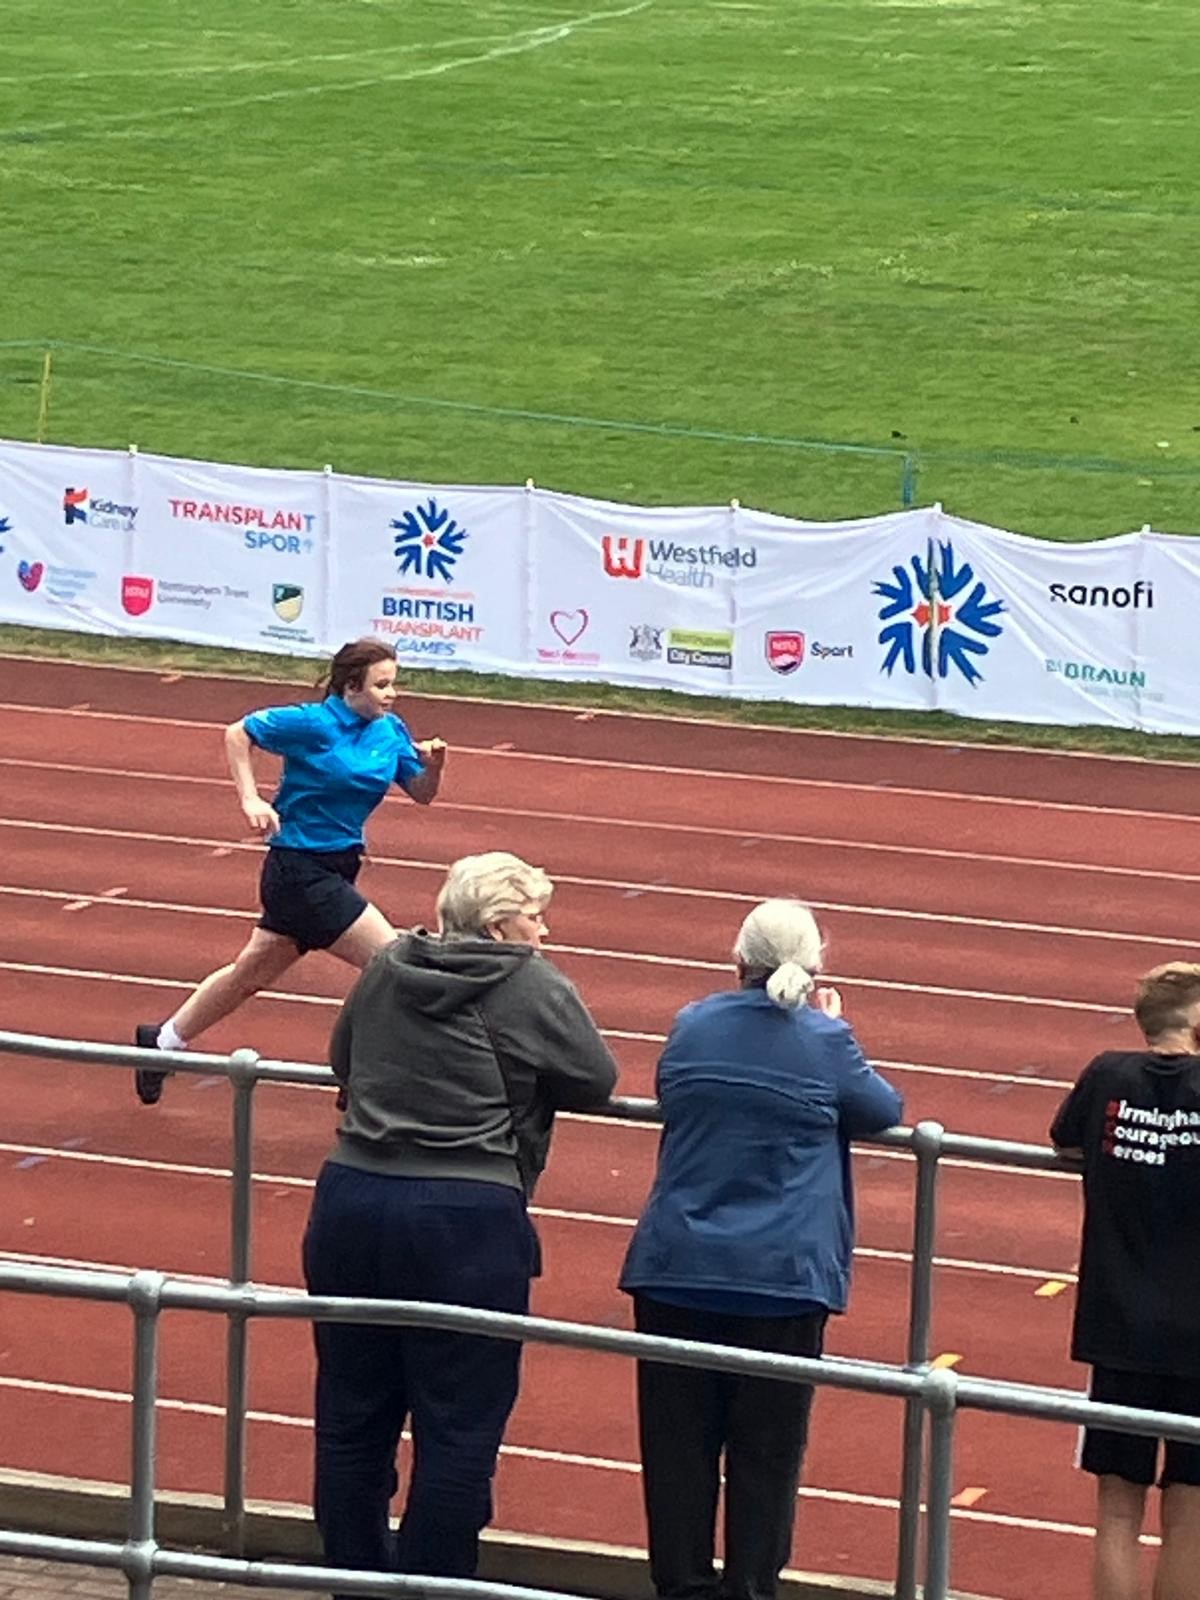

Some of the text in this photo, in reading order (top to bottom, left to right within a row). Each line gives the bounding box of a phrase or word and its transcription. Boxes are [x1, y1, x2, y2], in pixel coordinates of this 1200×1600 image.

[169, 499, 315, 532] TRANSPLANT
[650, 540, 757, 568] Westfield
[1049, 580, 1153, 608] sanofi
[382, 597, 474, 622] BRITISH
[370, 618, 484, 642] TRANSPLANT
[810, 641, 854, 660] Sport
